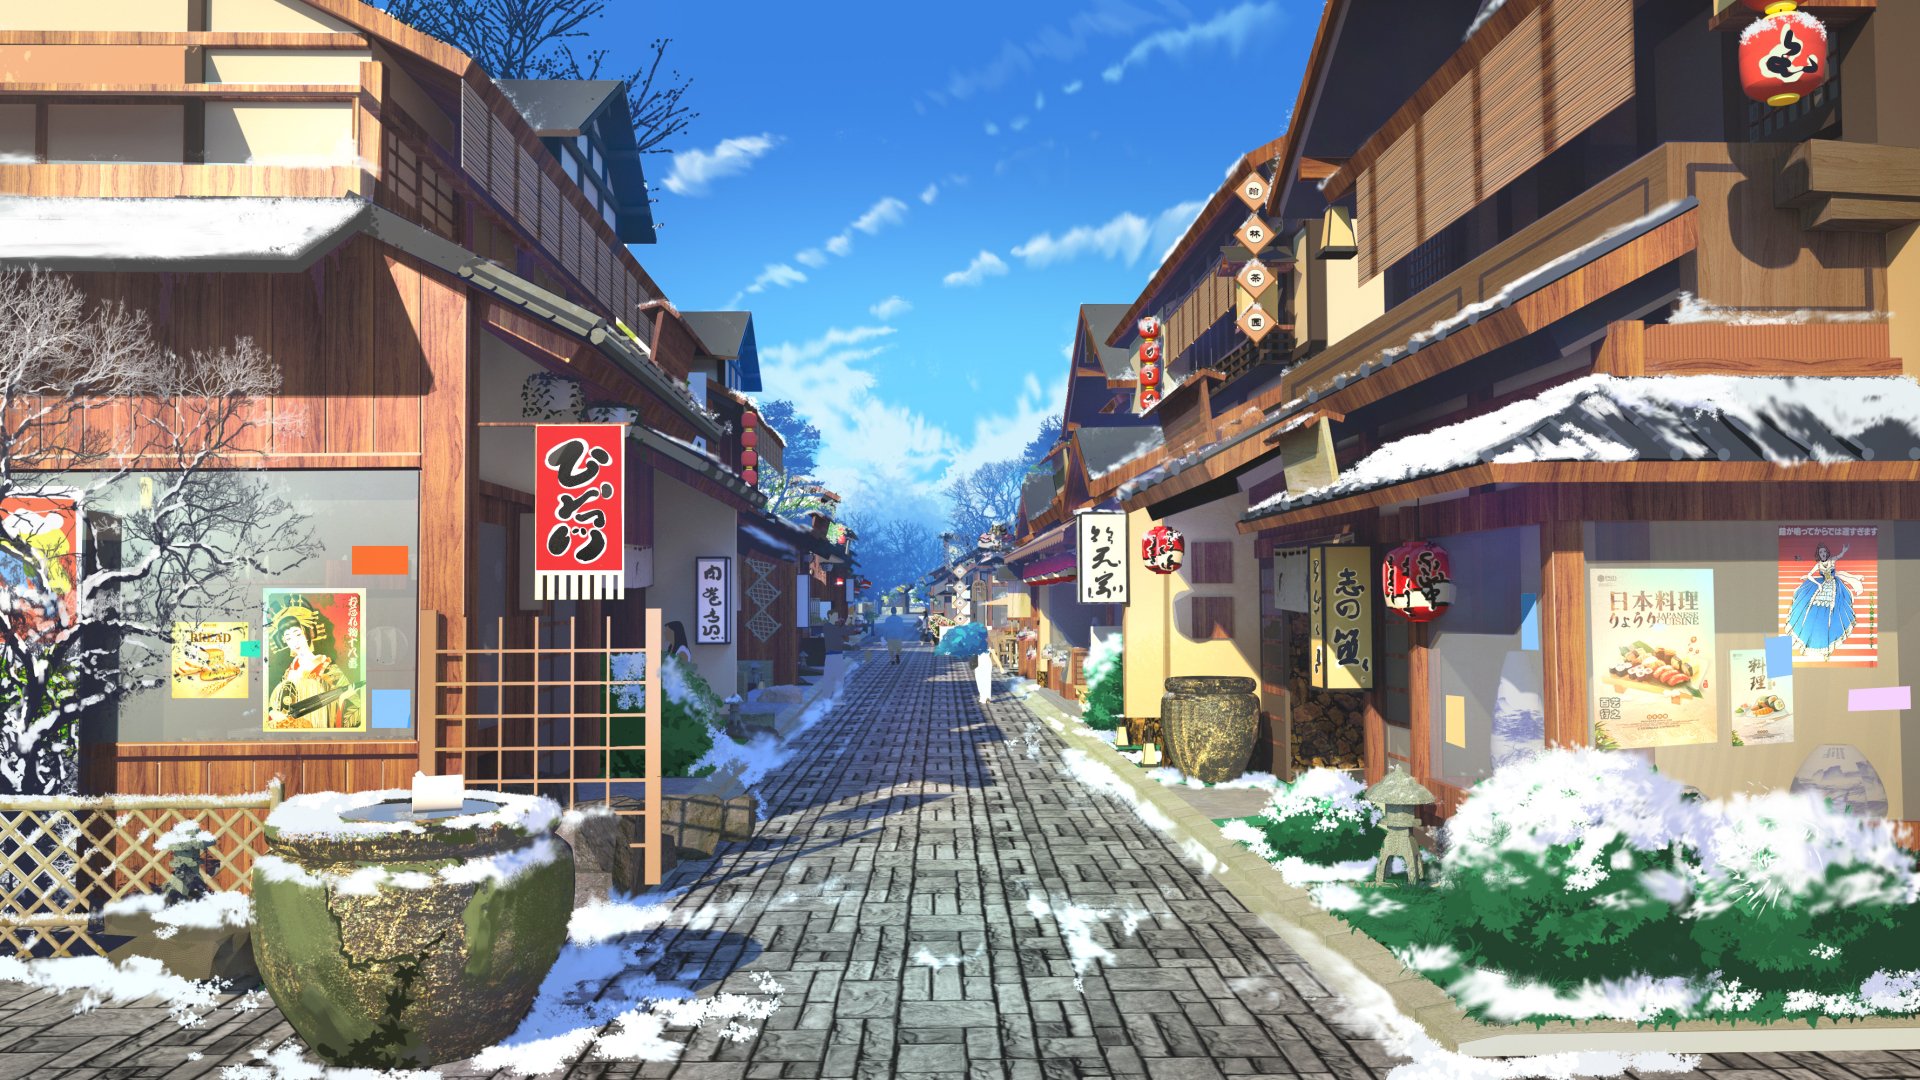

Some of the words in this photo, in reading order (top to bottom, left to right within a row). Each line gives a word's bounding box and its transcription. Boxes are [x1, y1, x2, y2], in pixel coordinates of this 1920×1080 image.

[1609, 590, 1699, 612] 日本料理
[1609, 611, 1657, 629] りょうり
[1656, 618, 1699, 626] CUISINE
[190, 632, 232, 644] BREAD
[1747, 656, 1767, 691] 料理
